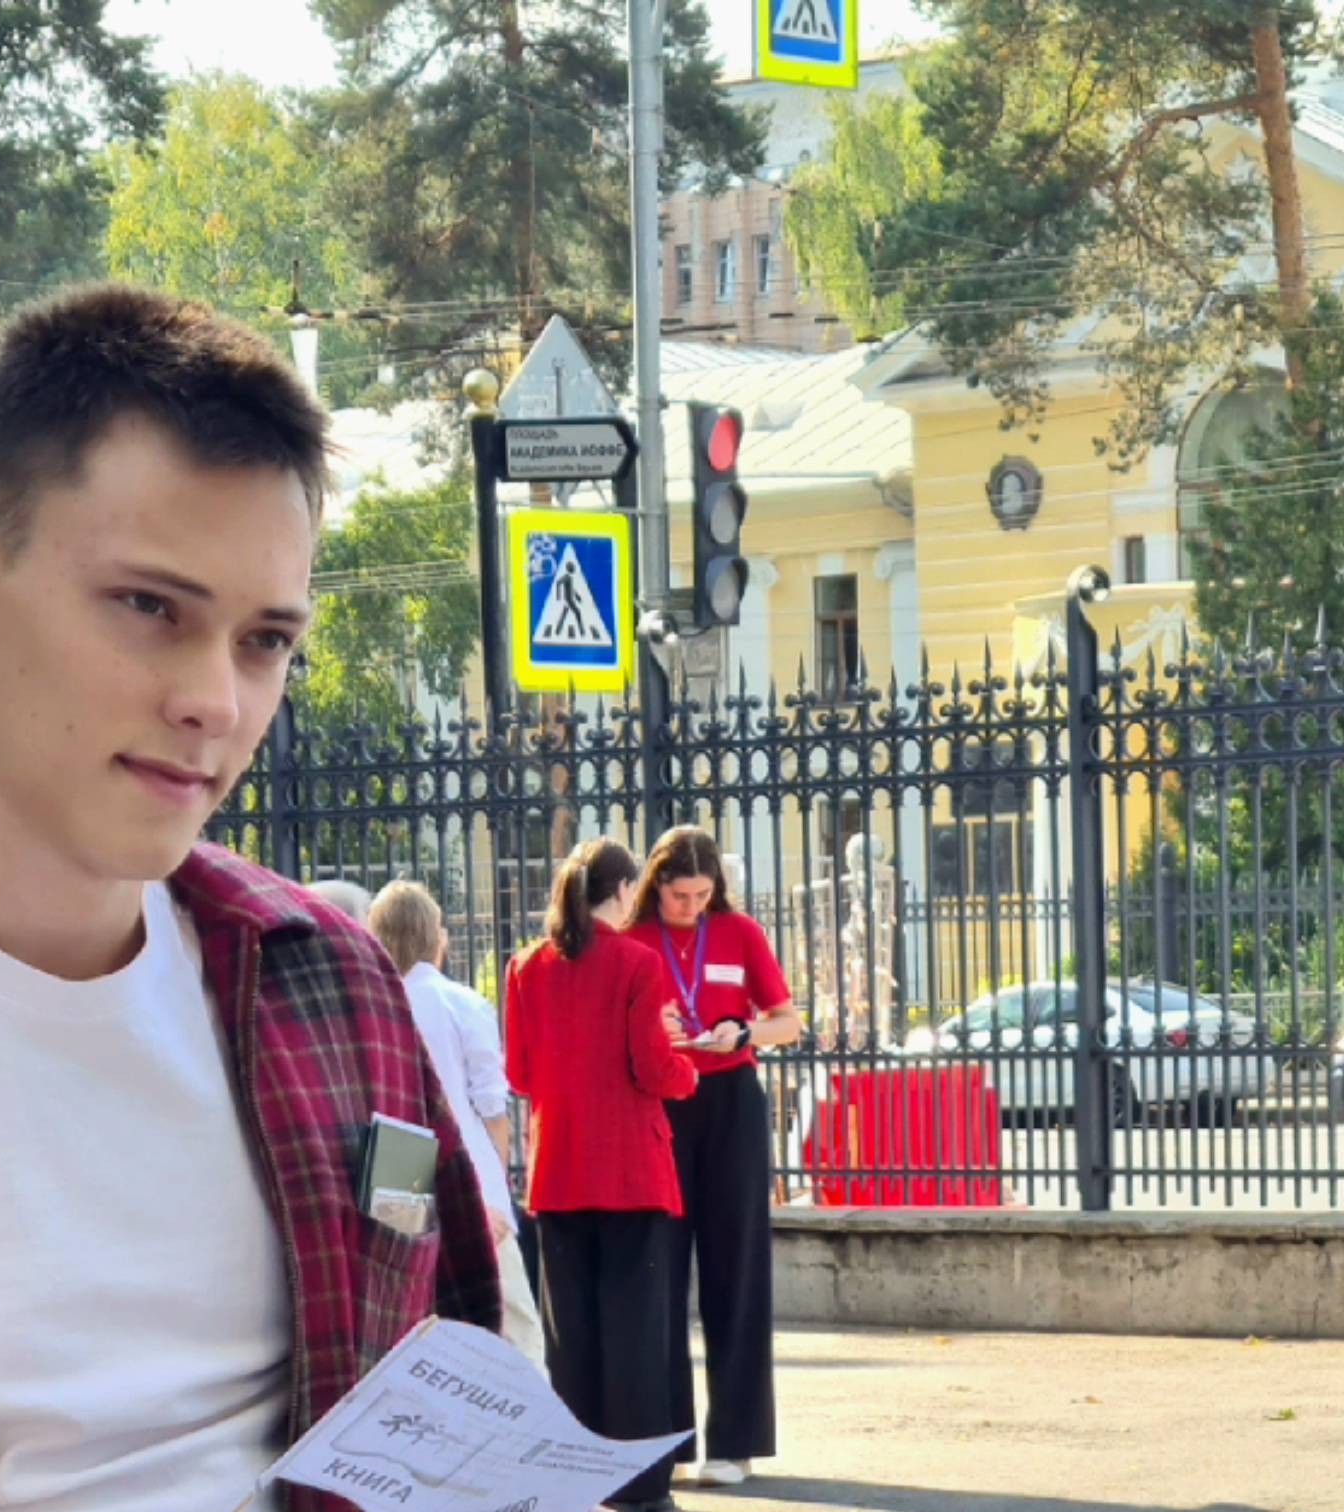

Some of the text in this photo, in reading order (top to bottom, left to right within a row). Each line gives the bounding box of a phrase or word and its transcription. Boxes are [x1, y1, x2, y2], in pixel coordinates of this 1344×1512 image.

[510, 443, 625, 459] АКАДЕМИКА ИОФФЕ
[408, 1358, 527, 1421] БЕГУЩАЯ
[321, 1459, 414, 1503] КНИГА
